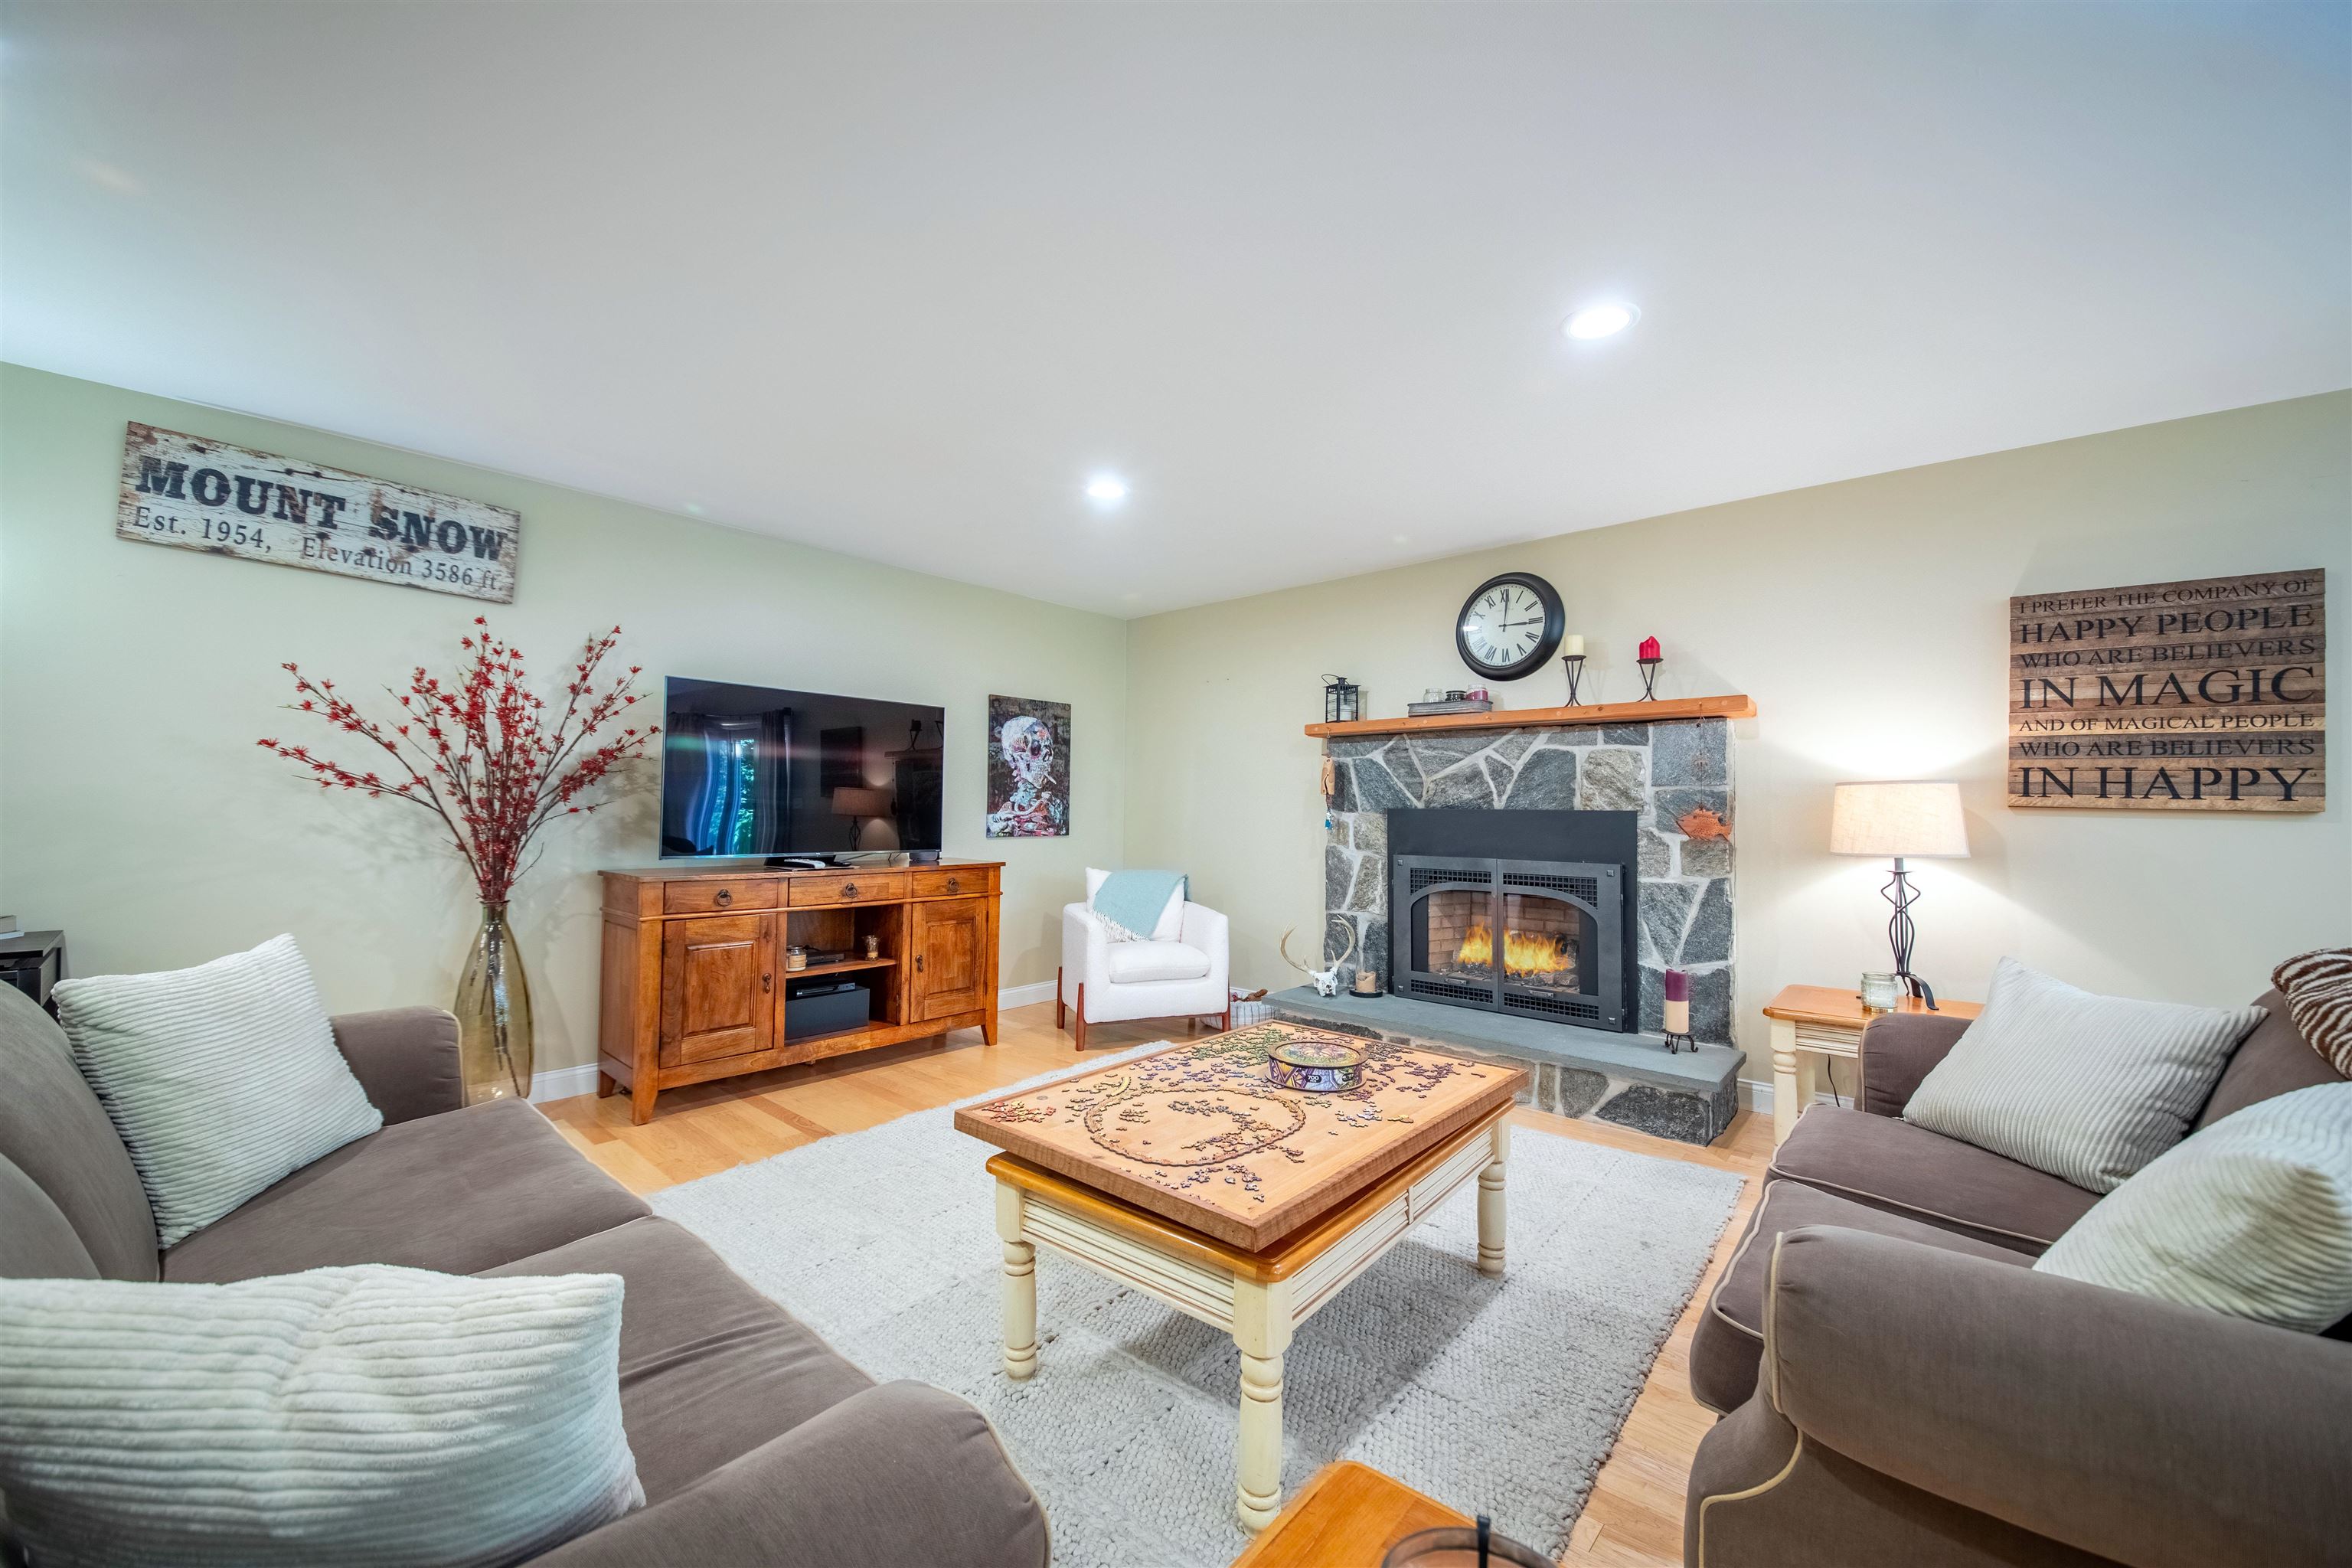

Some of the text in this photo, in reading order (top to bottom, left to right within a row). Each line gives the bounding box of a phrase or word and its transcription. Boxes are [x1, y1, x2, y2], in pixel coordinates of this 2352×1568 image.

[135, 455, 508, 560] MOUNT SNOW
[133, 506, 503, 591] Est. 1954, Elevation 3586 ft.
[2020, 579, 2315, 613] I PREFER THE COMPANY OF
[2020, 604, 2315, 643] HAPPY PEOPLE
[2020, 638, 2316, 668] WHO ARE BELIEVERS
[2020, 666, 2314, 709] IN MAGIC
[2019, 713, 2315, 732] AND OF MAGICAL PEOPLE
[2018, 738, 2315, 756] WHO ARE BELIEVERS
[2017, 766, 2314, 802] IN HAPPY
